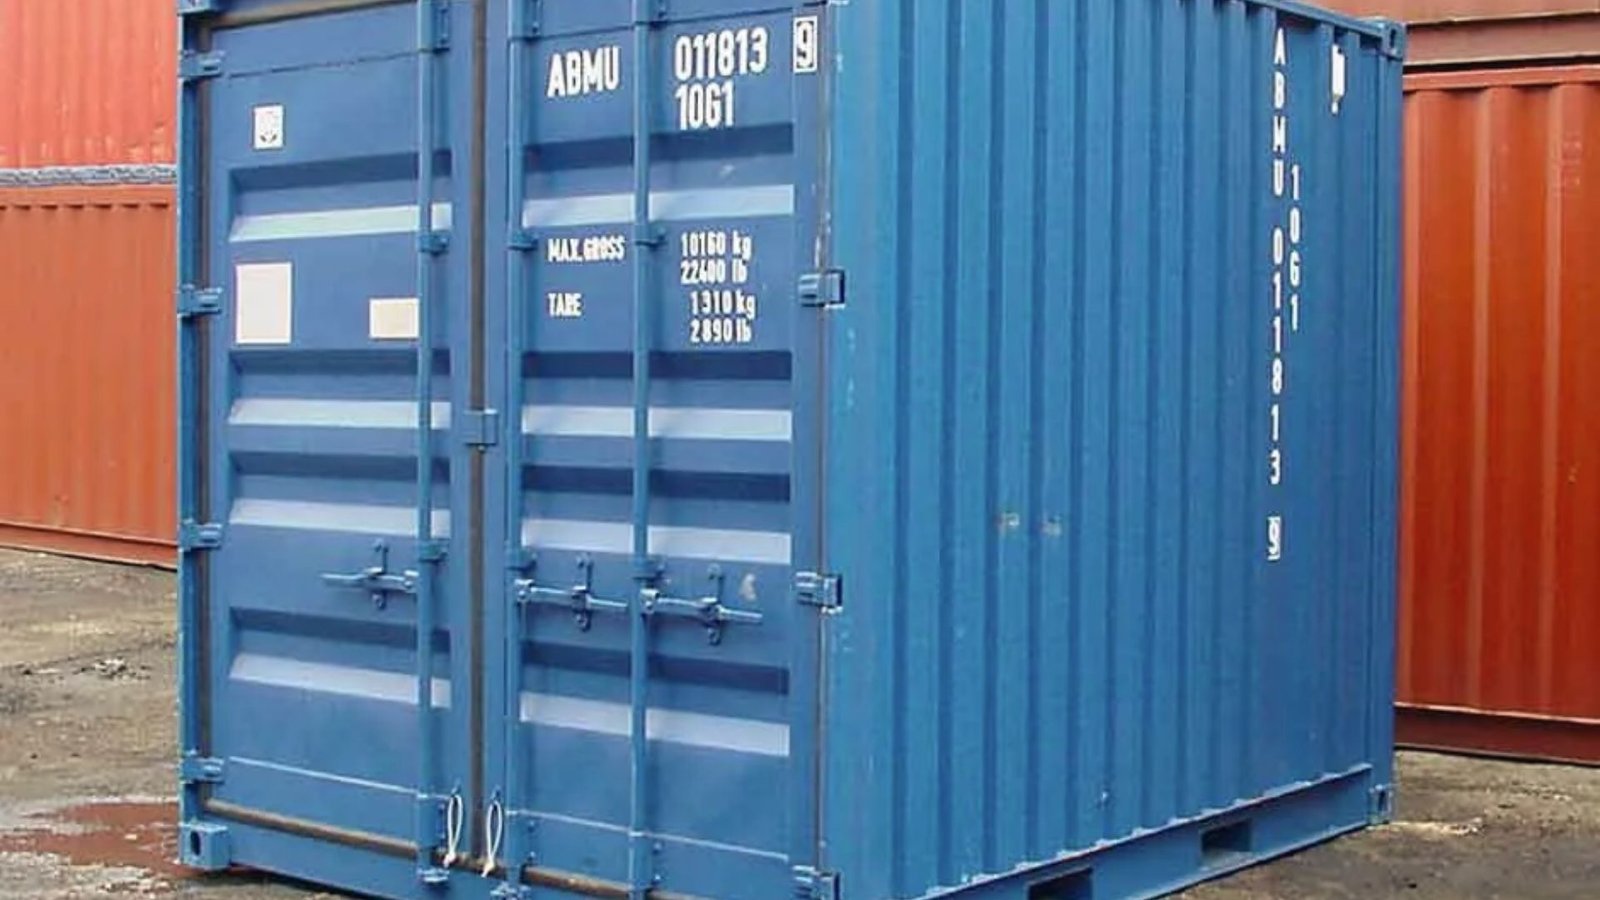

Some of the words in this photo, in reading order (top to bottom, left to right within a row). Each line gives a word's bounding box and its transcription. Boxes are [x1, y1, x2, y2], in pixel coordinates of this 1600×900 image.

[548, 46, 620, 98] ABMU
[675, 27, 768, 81] 011813
[795, 20, 814, 70] 9
[675, 81, 734, 130] 10G1
[1273, 28, 1286, 196] ABMU
[681, 231, 727, 257] 10160
[732, 230, 752, 261] kg
[1290, 165, 1300, 330] 10G1
[680, 258, 726, 284] 22400
[732, 257, 750, 283] lb
[548, 292, 583, 317] TARE
[690, 290, 733, 315] 1310
[735, 289, 756, 320] kg
[690, 318, 733, 343] 2890
[736, 317, 753, 343] lb
[1271, 228, 1284, 485] 011813
[1269, 517, 1281, 559] 9
